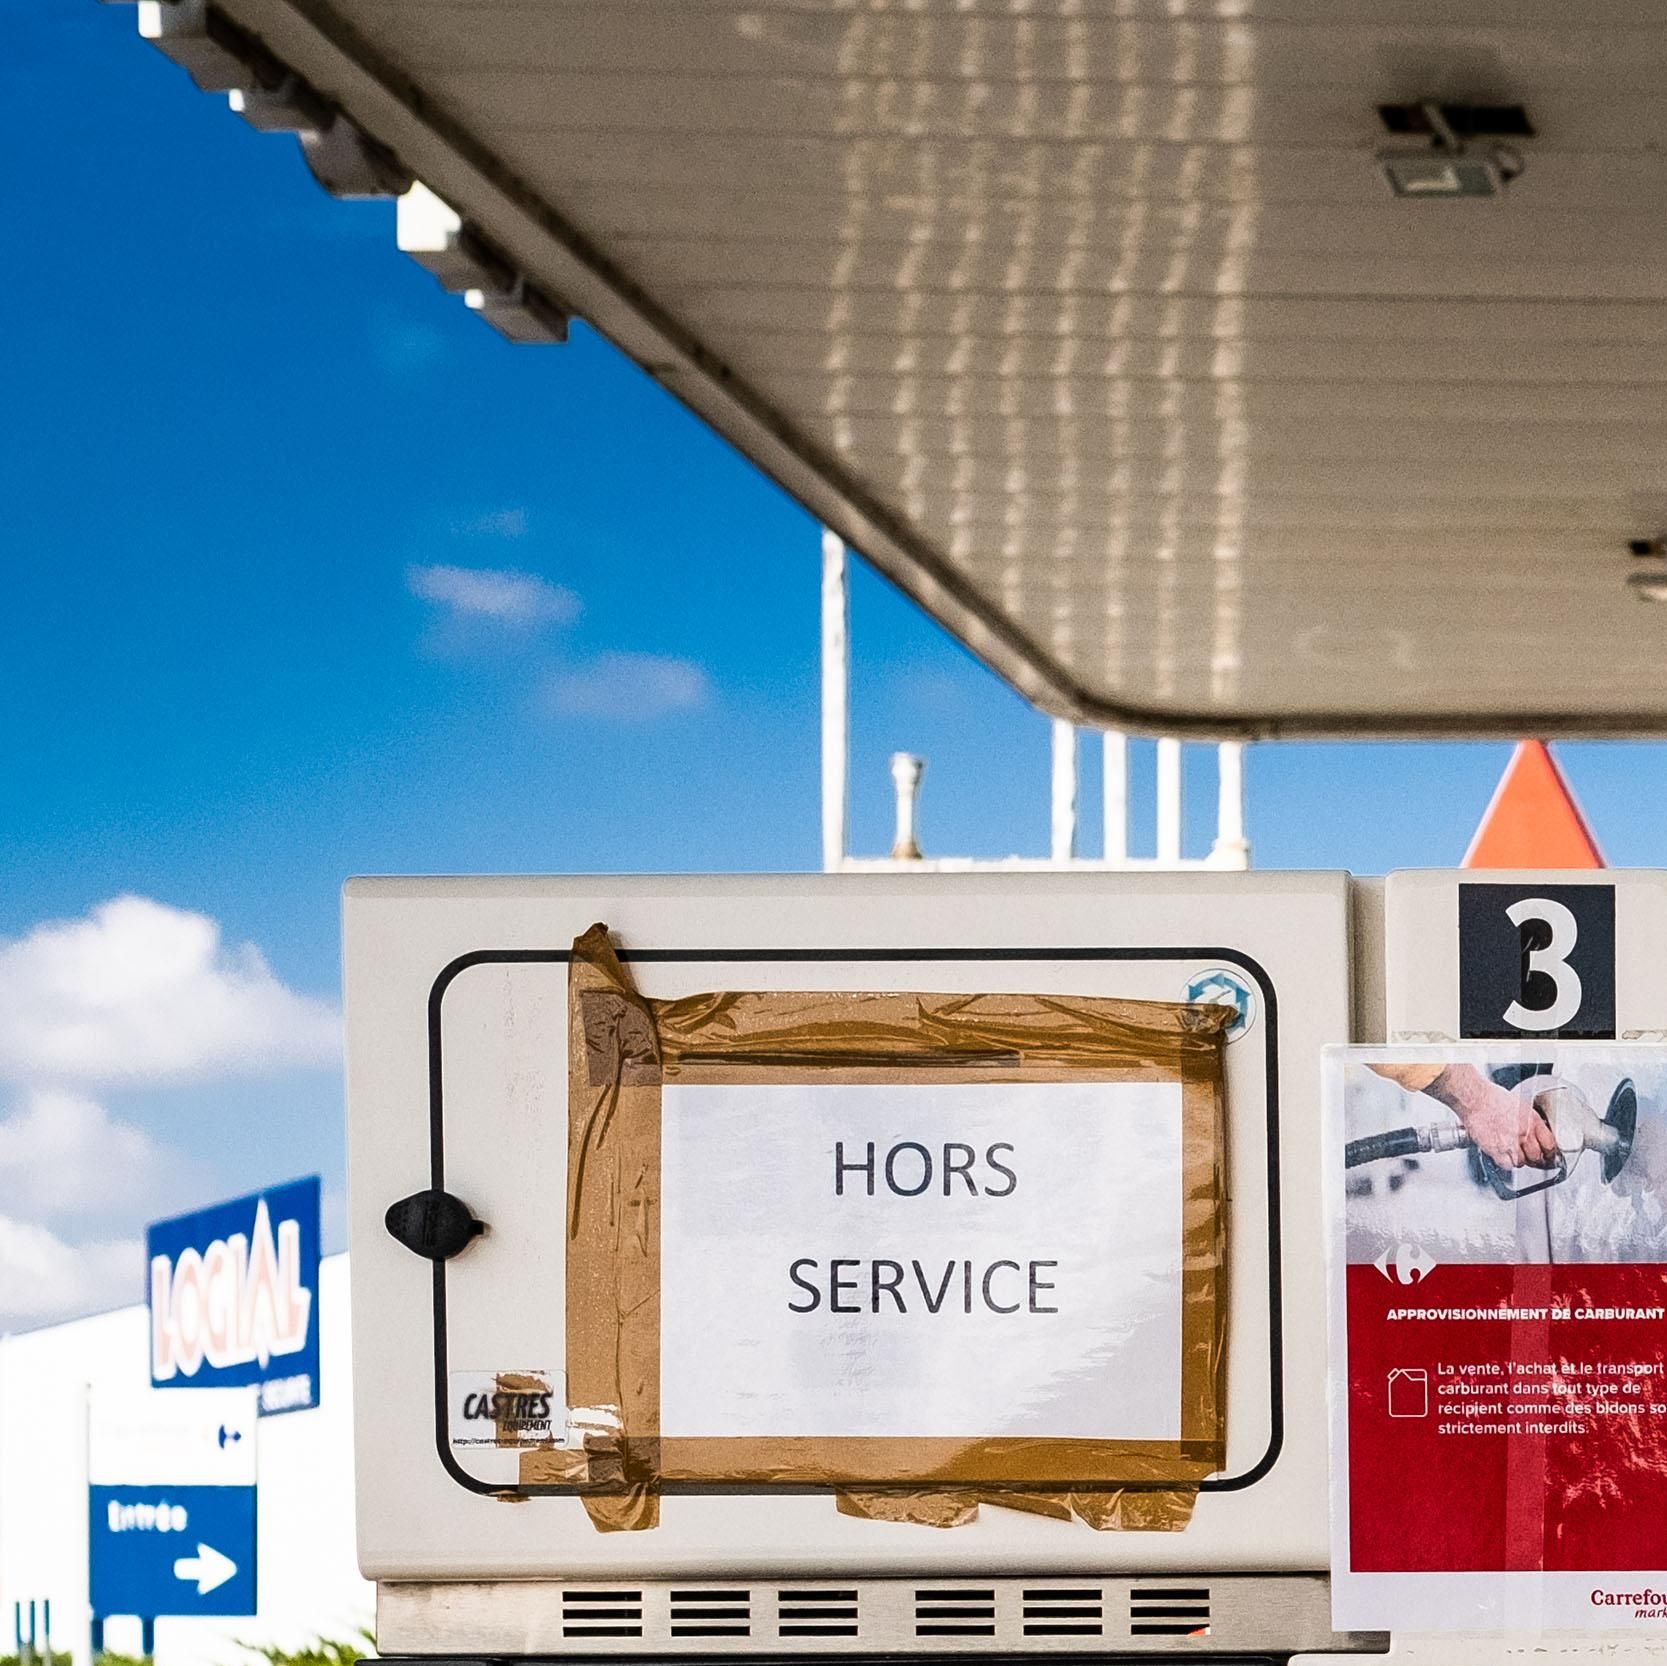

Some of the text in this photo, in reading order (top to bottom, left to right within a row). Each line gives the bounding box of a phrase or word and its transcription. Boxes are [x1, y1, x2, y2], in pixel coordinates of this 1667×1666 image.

[1502, 897, 1582, 1031] 3
[834, 1141, 1018, 1197] HORS
[787, 1259, 1058, 1315] SERVICE
[1386, 1307, 1665, 1321] APPROVISIONNEMENT DE CARBURANT
[1438, 1362, 1454, 1375] La
[1459, 1363, 1504, 1377] vente,
[1508, 1361, 1557, 1375] l'achat
[1561, 1363, 1575, 1375] et
[1580, 1361, 1592, 1375] le
[1597, 1362, 1664, 1379] transport
[1438, 1382, 1641, 1398] carburant dans tout type de
[463, 1392, 553, 1419] CASTRES
[1438, 1402, 1502, 1417] récipient
[1507, 1404, 1562, 1415] comme
[1565, 1402, 1591, 1415] des
[1596, 1402, 1646, 1415] bidons
[1438, 1421, 1588, 1435] strictement interdits.
